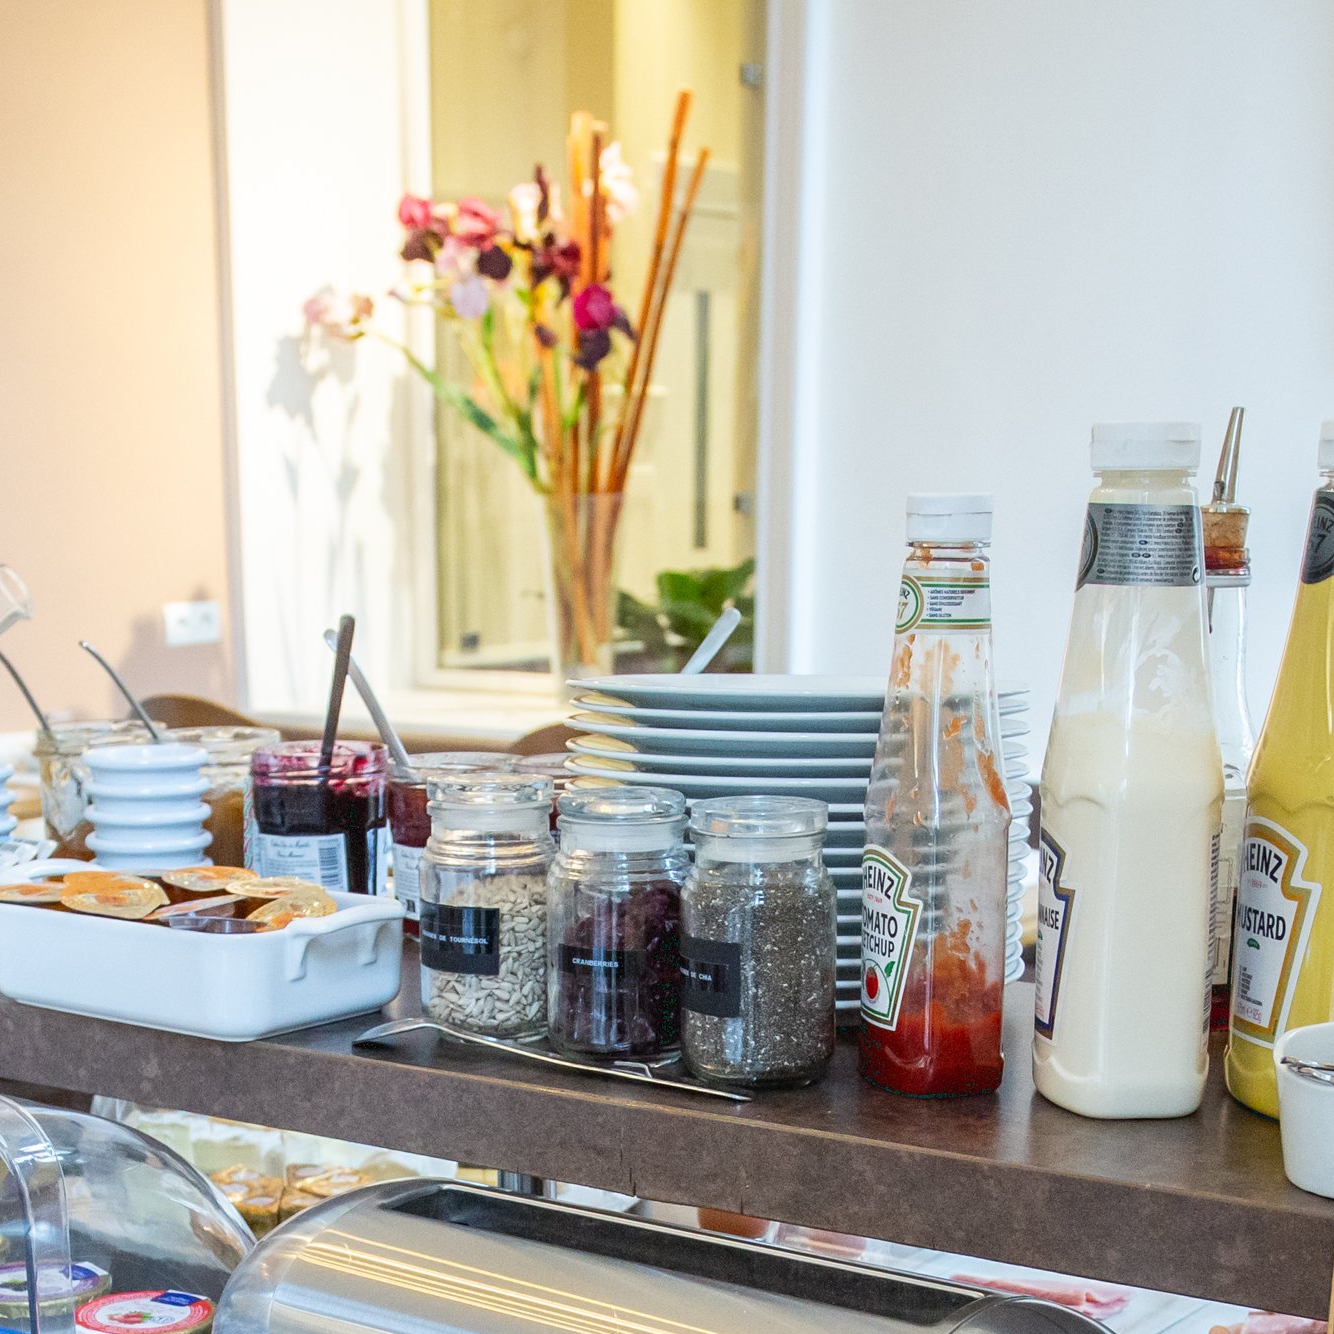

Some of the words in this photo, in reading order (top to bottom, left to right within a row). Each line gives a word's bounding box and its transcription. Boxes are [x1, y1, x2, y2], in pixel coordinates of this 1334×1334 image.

[1244, 843, 1282, 884] HEINZ
[862, 905, 898, 938] OMATO
[863, 933, 894, 958] ETCHUP
[572, 957, 619, 968] CRANBERRIES
